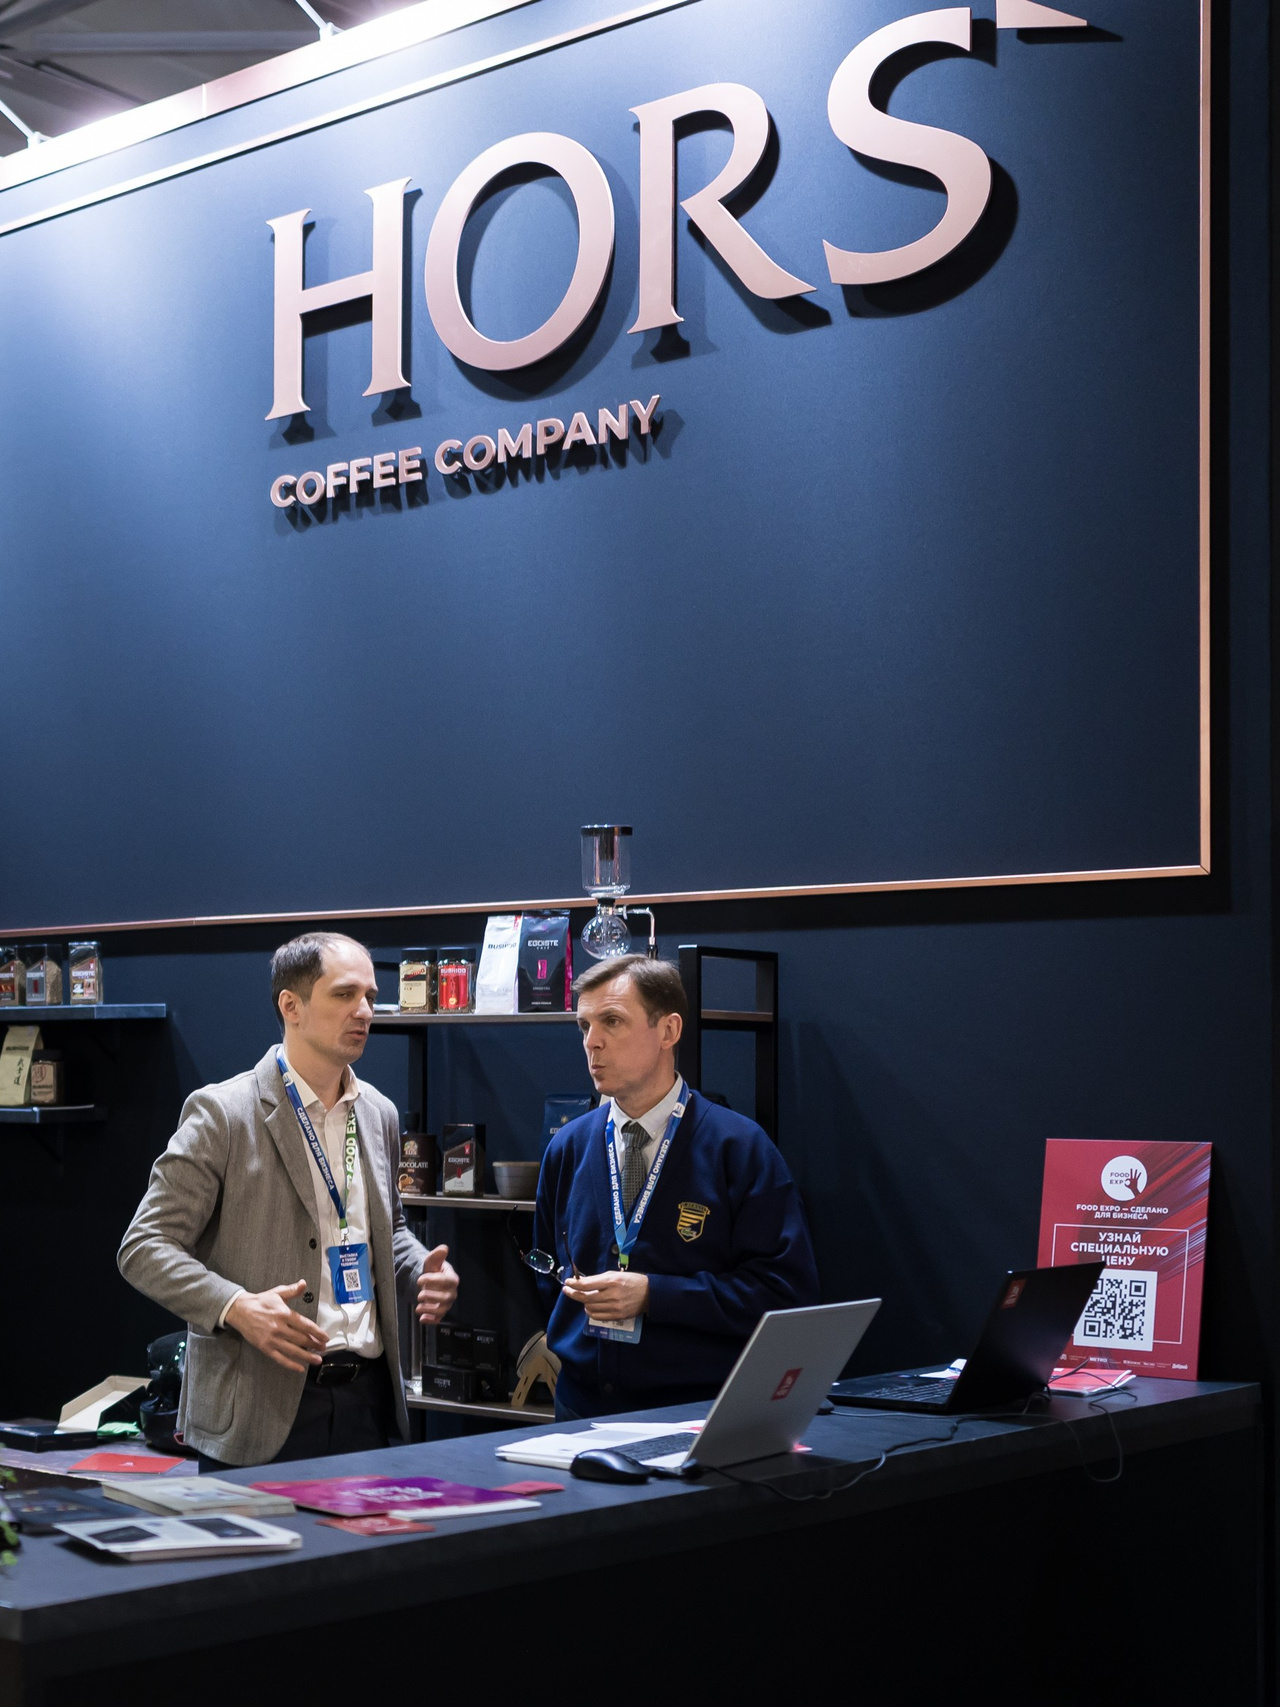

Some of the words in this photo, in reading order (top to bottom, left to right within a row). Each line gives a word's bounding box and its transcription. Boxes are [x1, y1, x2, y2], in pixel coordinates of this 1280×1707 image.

[264, 6, 993, 421] HORS
[270, 446, 422, 508] COFFEE
[433, 394, 661, 475] COMPANY
[527, 939, 559, 947] EGOISTE
[297, 1107, 315, 1141] СДЕЛАНО
[310, 1141, 322, 1157] ДЛЯ
[319, 1156, 335, 1190] БИЗНЕСА
[345, 1137, 357, 1173] FOOD
[608, 1142, 617, 1174] БИЗНЕСА
[652, 1139, 670, 1174] СДЕЛАНО
[611, 1174, 620, 1190] ДЛЯ
[645, 1173, 656, 1189] ДЛЯ
[612, 1191, 624, 1225] СДЕЛАНО
[633, 1189, 651, 1223] БИЗНЕСА
[1112, 1212, 1148, 1220] БИЗНЕСА
[1130, 1206, 1169, 1214] СДЕЛАНО
[1070, 1242, 1169, 1256] СПЕЦИАЛЬНУЮ
[1098, 1231, 1141, 1243] УЗНАЙ
[1102, 1255, 1135, 1266] ЦЕНУ
